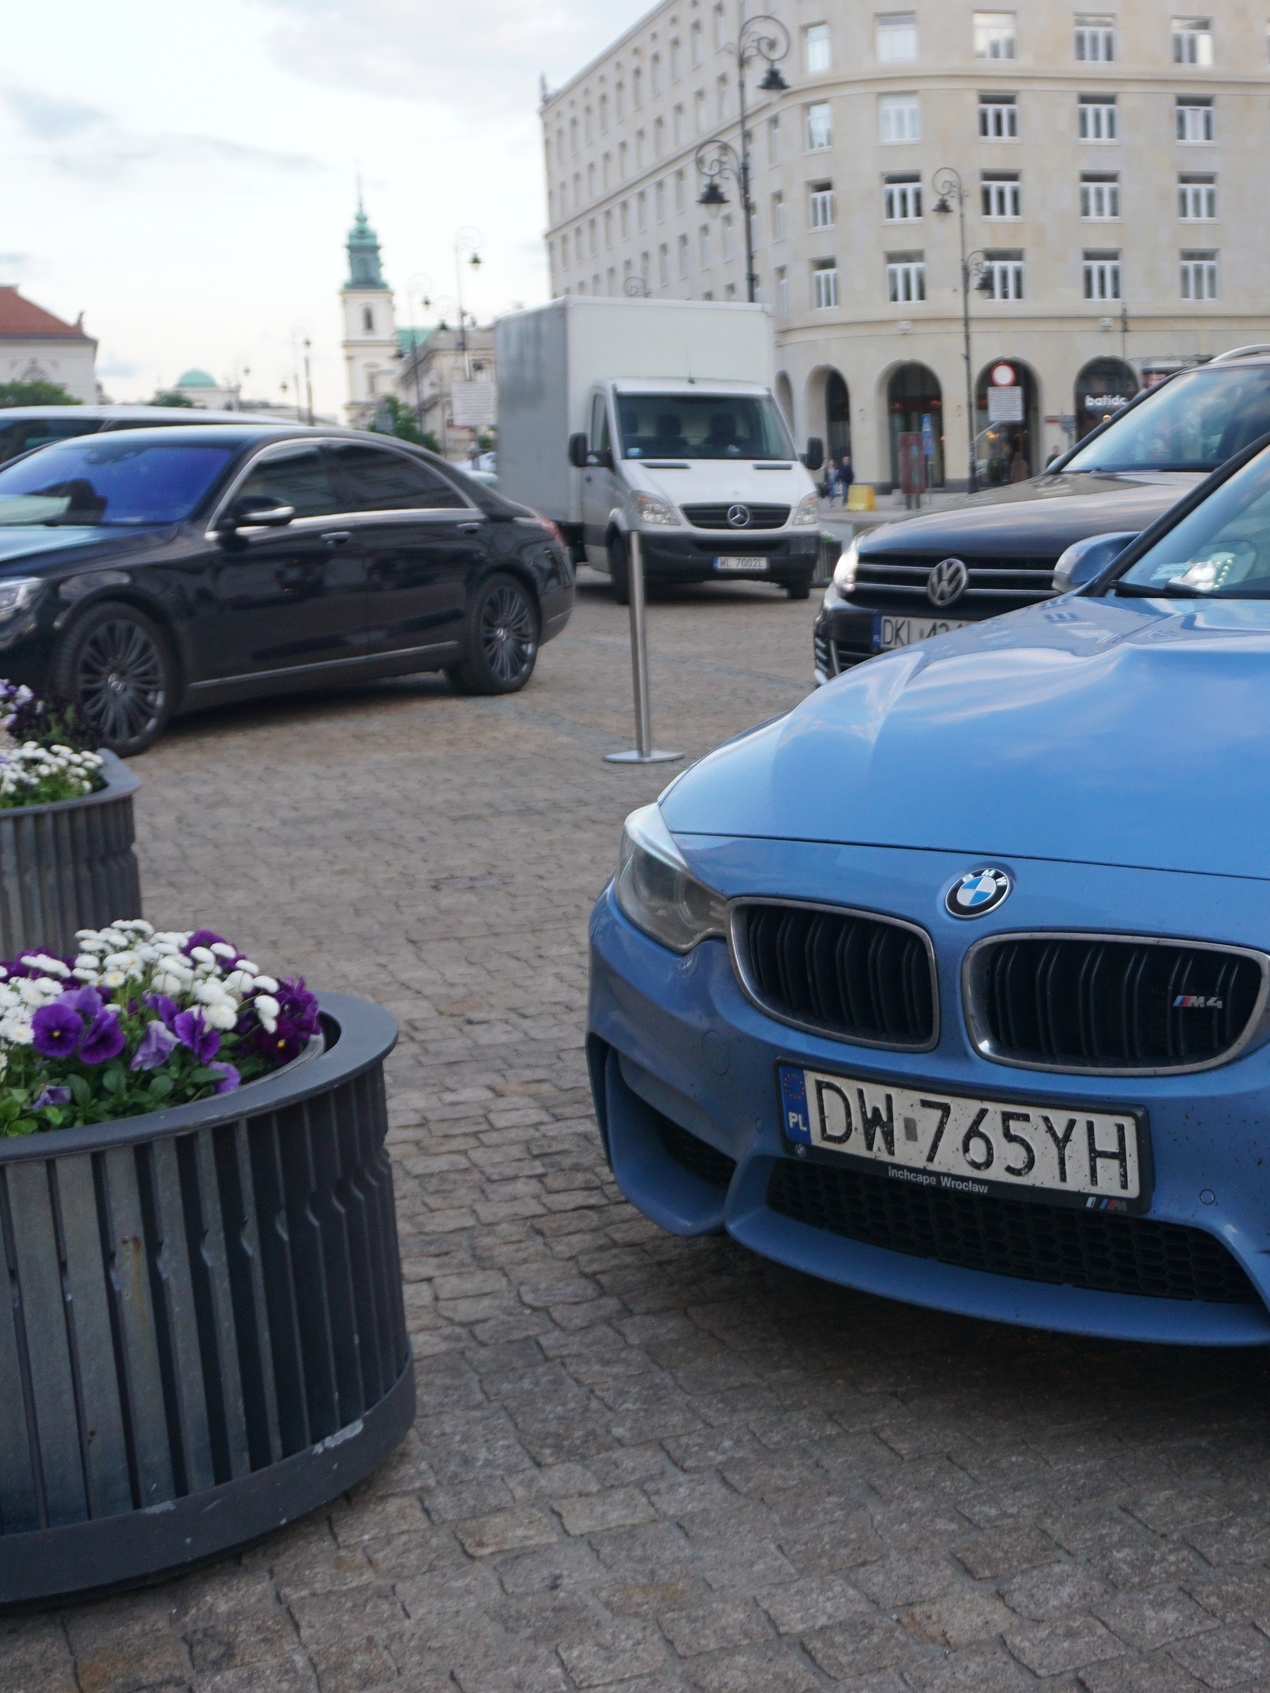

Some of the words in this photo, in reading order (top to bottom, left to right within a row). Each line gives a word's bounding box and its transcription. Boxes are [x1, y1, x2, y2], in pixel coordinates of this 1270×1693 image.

[962, 869, 1007, 886] BMW
[788, 1111, 807, 1132] PL
[814, 1078, 896, 1157] DW
[919, 1098, 1129, 1191] 765YH
[887, 1165, 937, 1186] Inchcape
[940, 1175, 989, 1194] Wrocław
